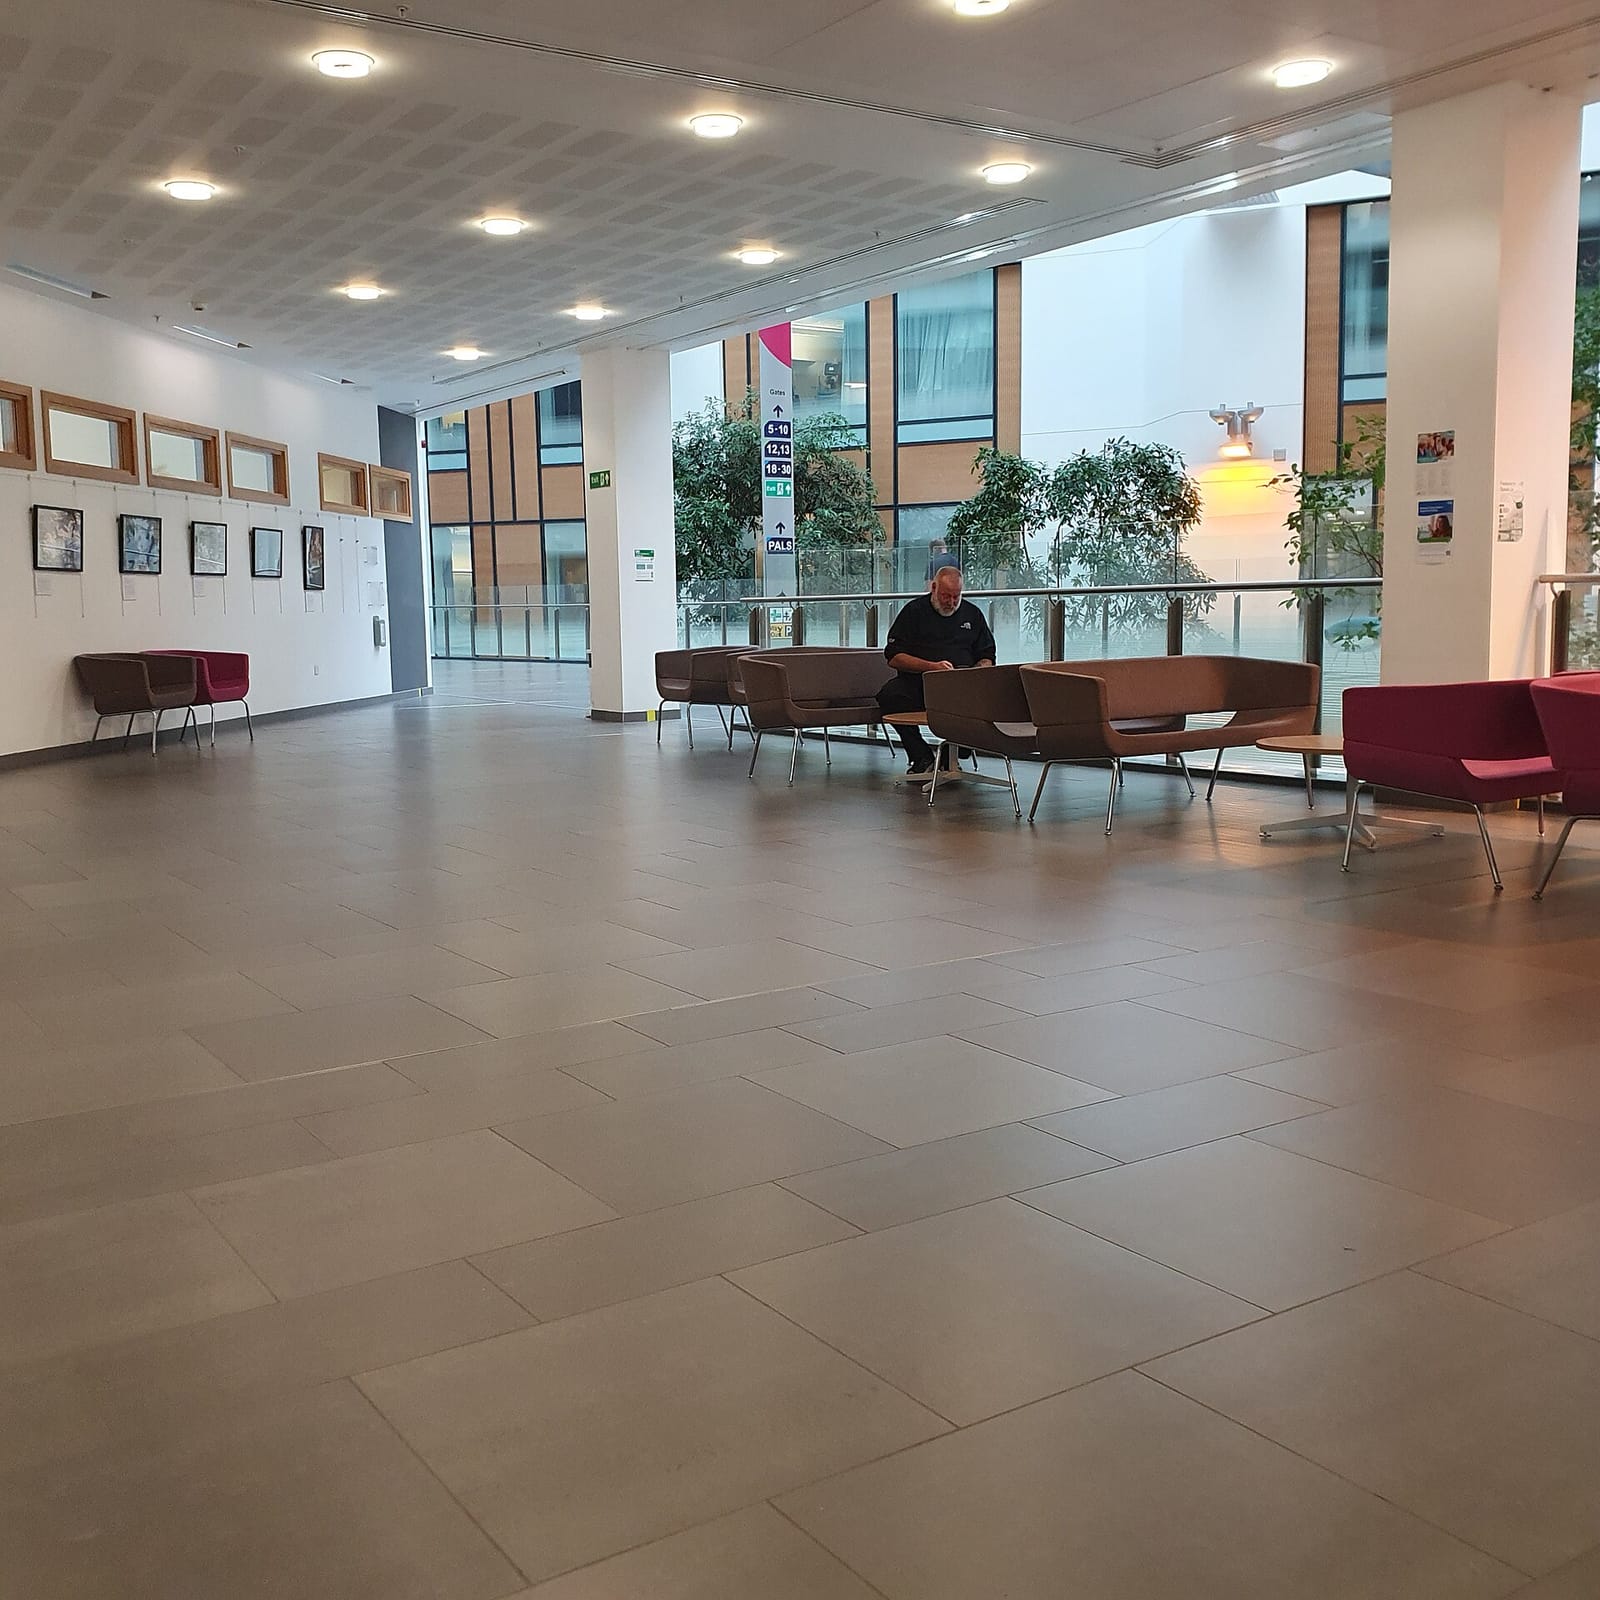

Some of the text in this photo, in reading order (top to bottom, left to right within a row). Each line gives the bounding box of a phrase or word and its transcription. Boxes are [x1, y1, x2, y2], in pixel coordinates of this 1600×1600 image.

[766, 443, 789, 456] 12,13
[766, 464, 791, 475] 18-30
[768, 541, 792, 551] PALS
